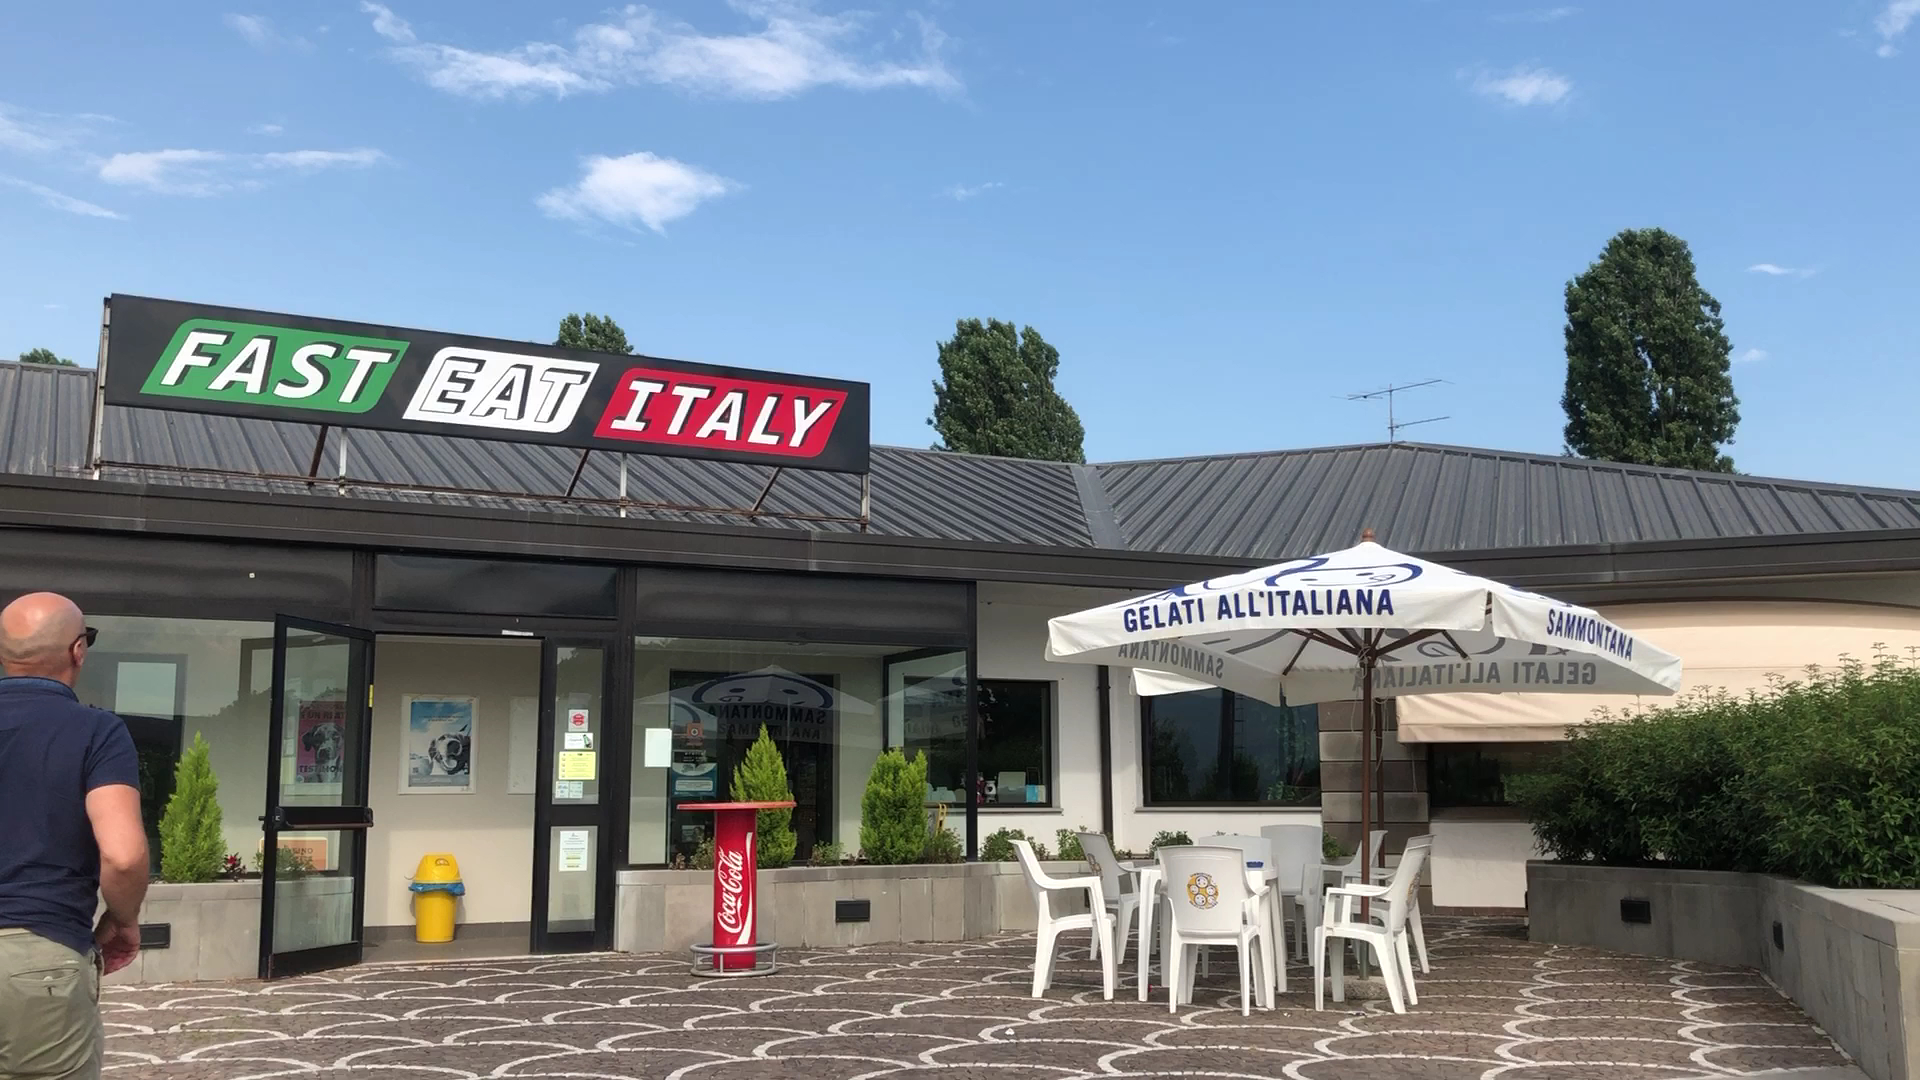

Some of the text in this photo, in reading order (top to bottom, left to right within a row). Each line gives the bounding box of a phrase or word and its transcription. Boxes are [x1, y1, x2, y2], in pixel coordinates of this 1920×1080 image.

[160, 329, 836, 448] FAST EAT ITALY
[1123, 589, 1394, 633] GELATI ALL'ITALIANA
[1546, 608, 1633, 662] SAMMONTANA
